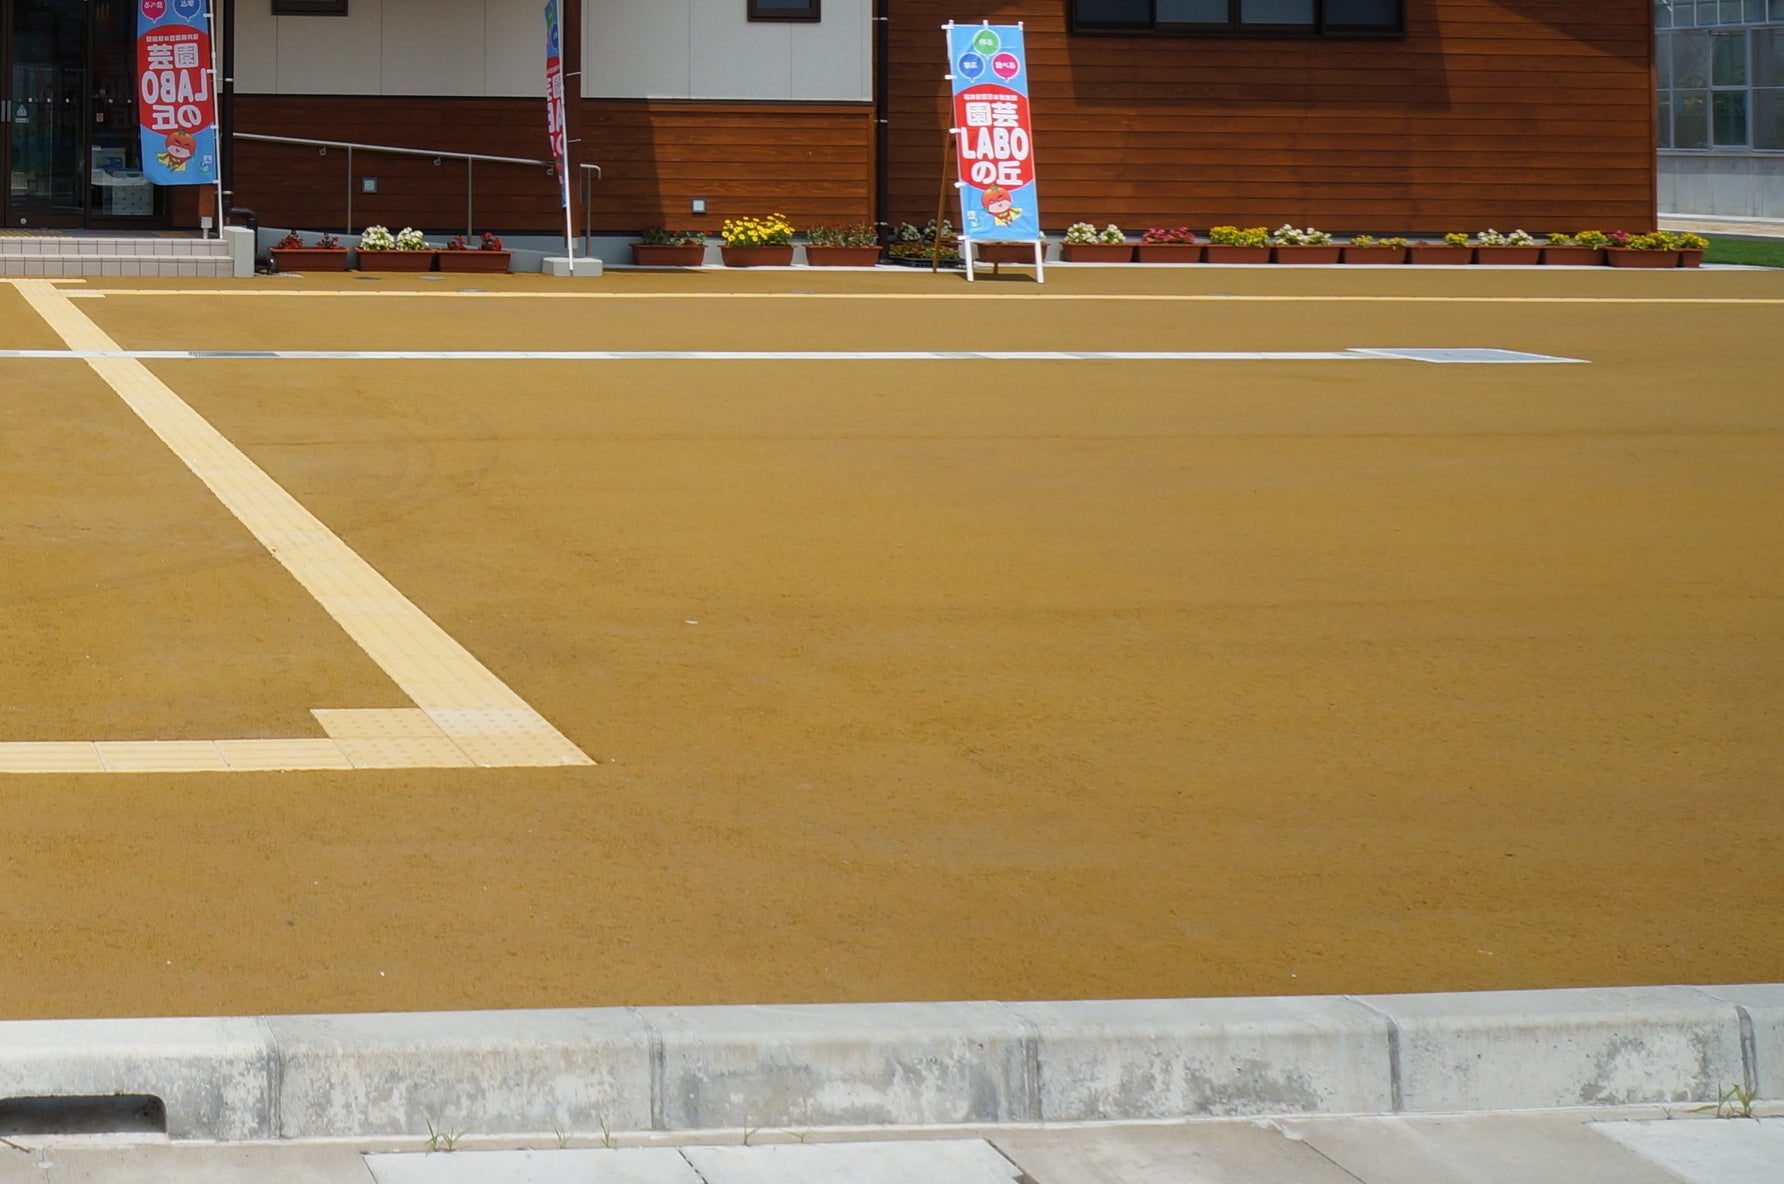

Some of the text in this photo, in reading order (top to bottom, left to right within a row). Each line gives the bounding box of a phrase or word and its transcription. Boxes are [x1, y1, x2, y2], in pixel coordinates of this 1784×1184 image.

[965, 102, 1019, 127] 園芸
[960, 126, 1029, 160] LABO
[971, 160, 1023, 185] の丘
